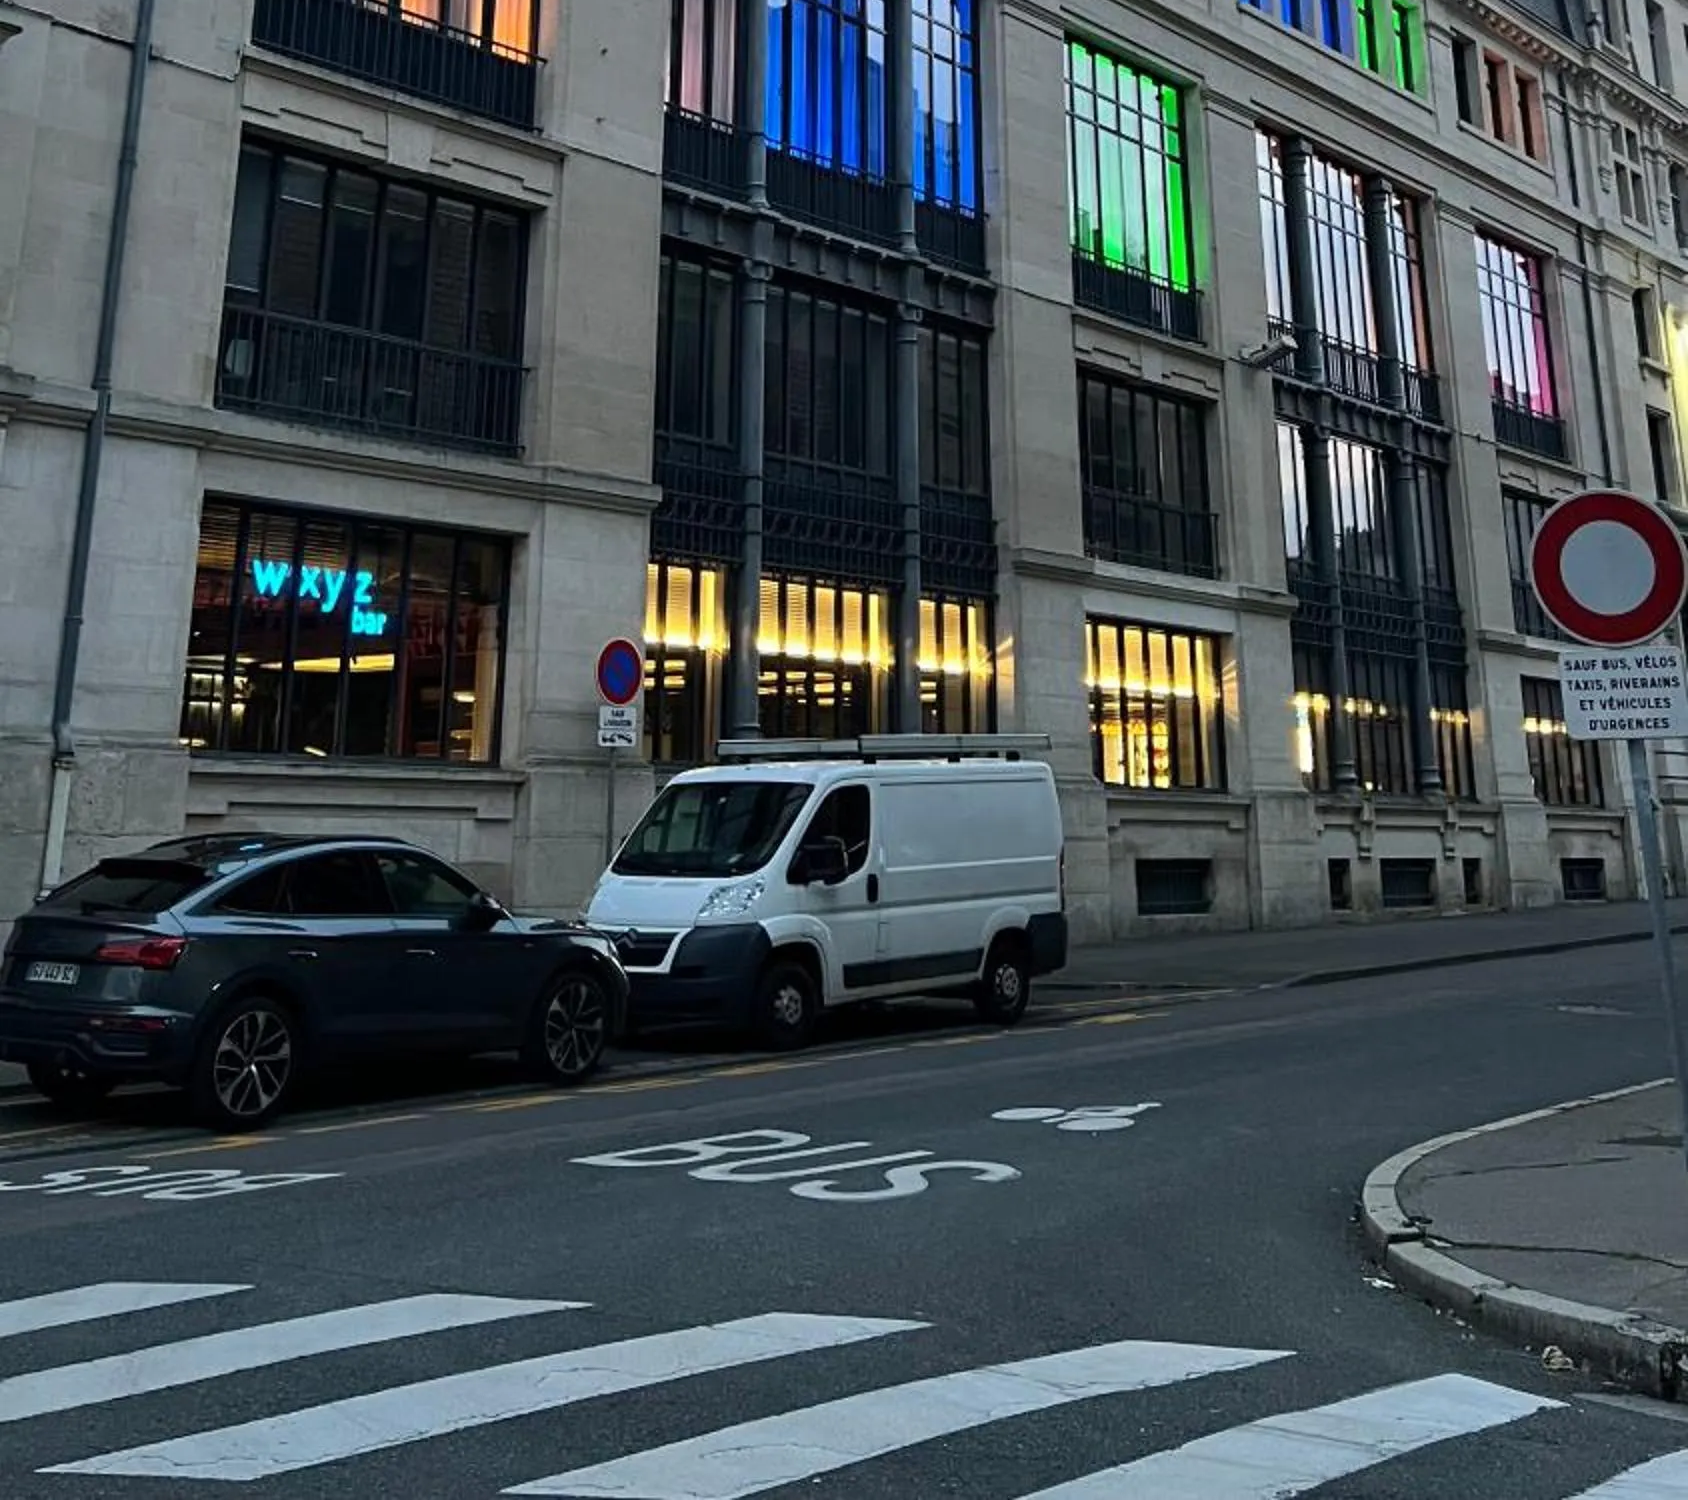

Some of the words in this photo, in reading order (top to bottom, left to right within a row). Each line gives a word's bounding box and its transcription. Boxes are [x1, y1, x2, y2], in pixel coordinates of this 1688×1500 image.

[352, 606, 386, 635] bar
[1564, 659, 1597, 671] SAUF
[1635, 655, 1677, 669] VÉLOS
[1610, 676, 1680, 689] RIVERAINS
[1579, 699, 1596, 711] ET
[1600, 695, 1671, 710] VÉHICULES
[1589, 718, 1670, 731] D'URGENCES
[570, 1129, 1022, 1201] BUS
